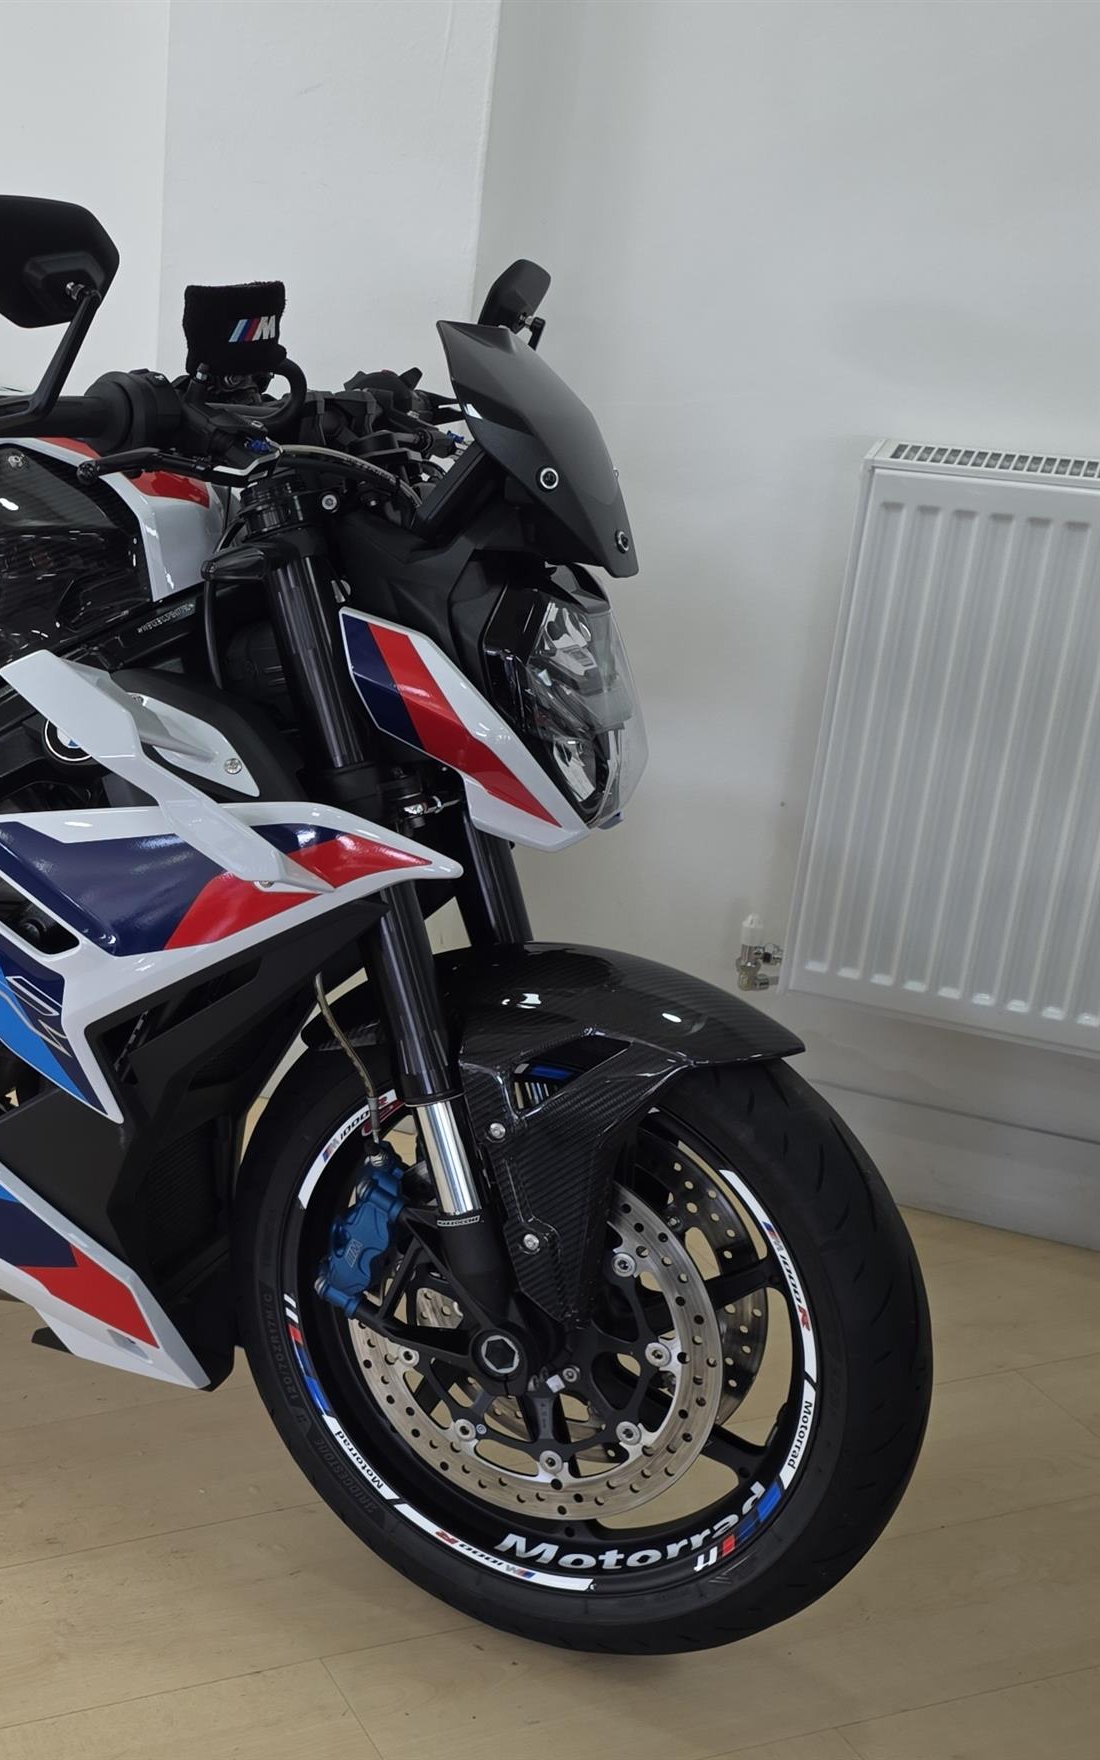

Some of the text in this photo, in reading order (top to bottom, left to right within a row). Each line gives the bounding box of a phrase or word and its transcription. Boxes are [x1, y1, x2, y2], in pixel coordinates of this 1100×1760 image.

[334, 1430, 385, 1490] Motorrad
[787, 1400, 813, 1470] Motorrad
[495, 1481, 766, 1570] Motorrad
